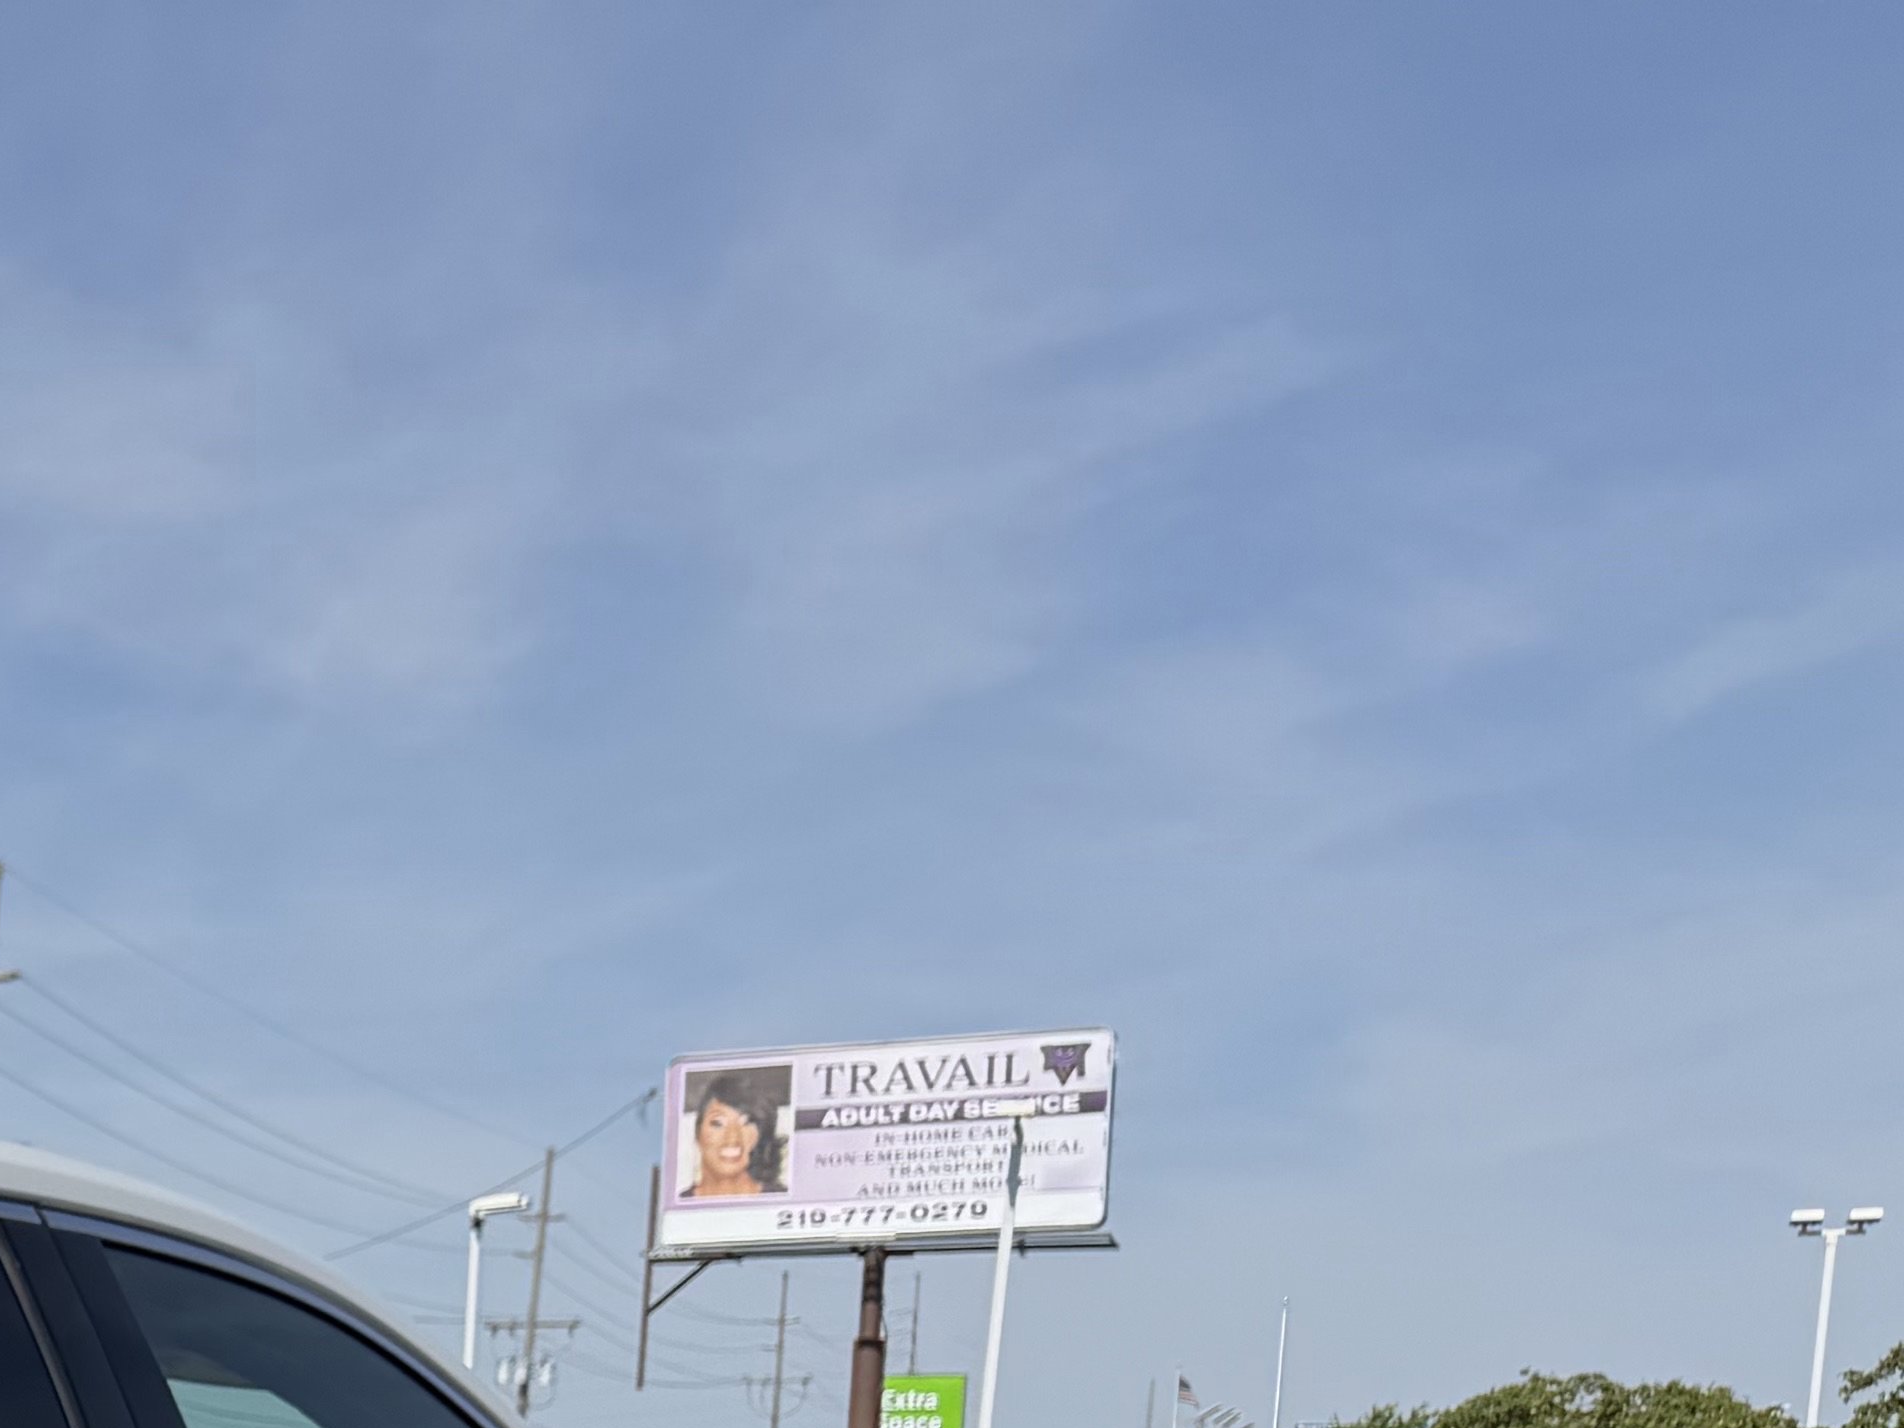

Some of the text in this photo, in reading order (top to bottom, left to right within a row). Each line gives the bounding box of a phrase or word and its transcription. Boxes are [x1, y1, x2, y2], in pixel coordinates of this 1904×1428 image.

[814, 1050, 1030, 1099] TRAVAIL
[821, 1103, 906, 1128] ADULT
[909, 1100, 960, 1122] DAY
[874, 1124, 1010, 1146] IN-HOME CAR
[815, 1139, 1085, 1168] NON-EMERGENCY MDICAL
[889, 1159, 1005, 1178] TRANSPORT
[857, 1181, 900, 1199] AND
[906, 1177, 965, 1197] MUCH
[777, 1199, 988, 1230] 219-777-0279
[881, 1389, 940, 1412] Extra
